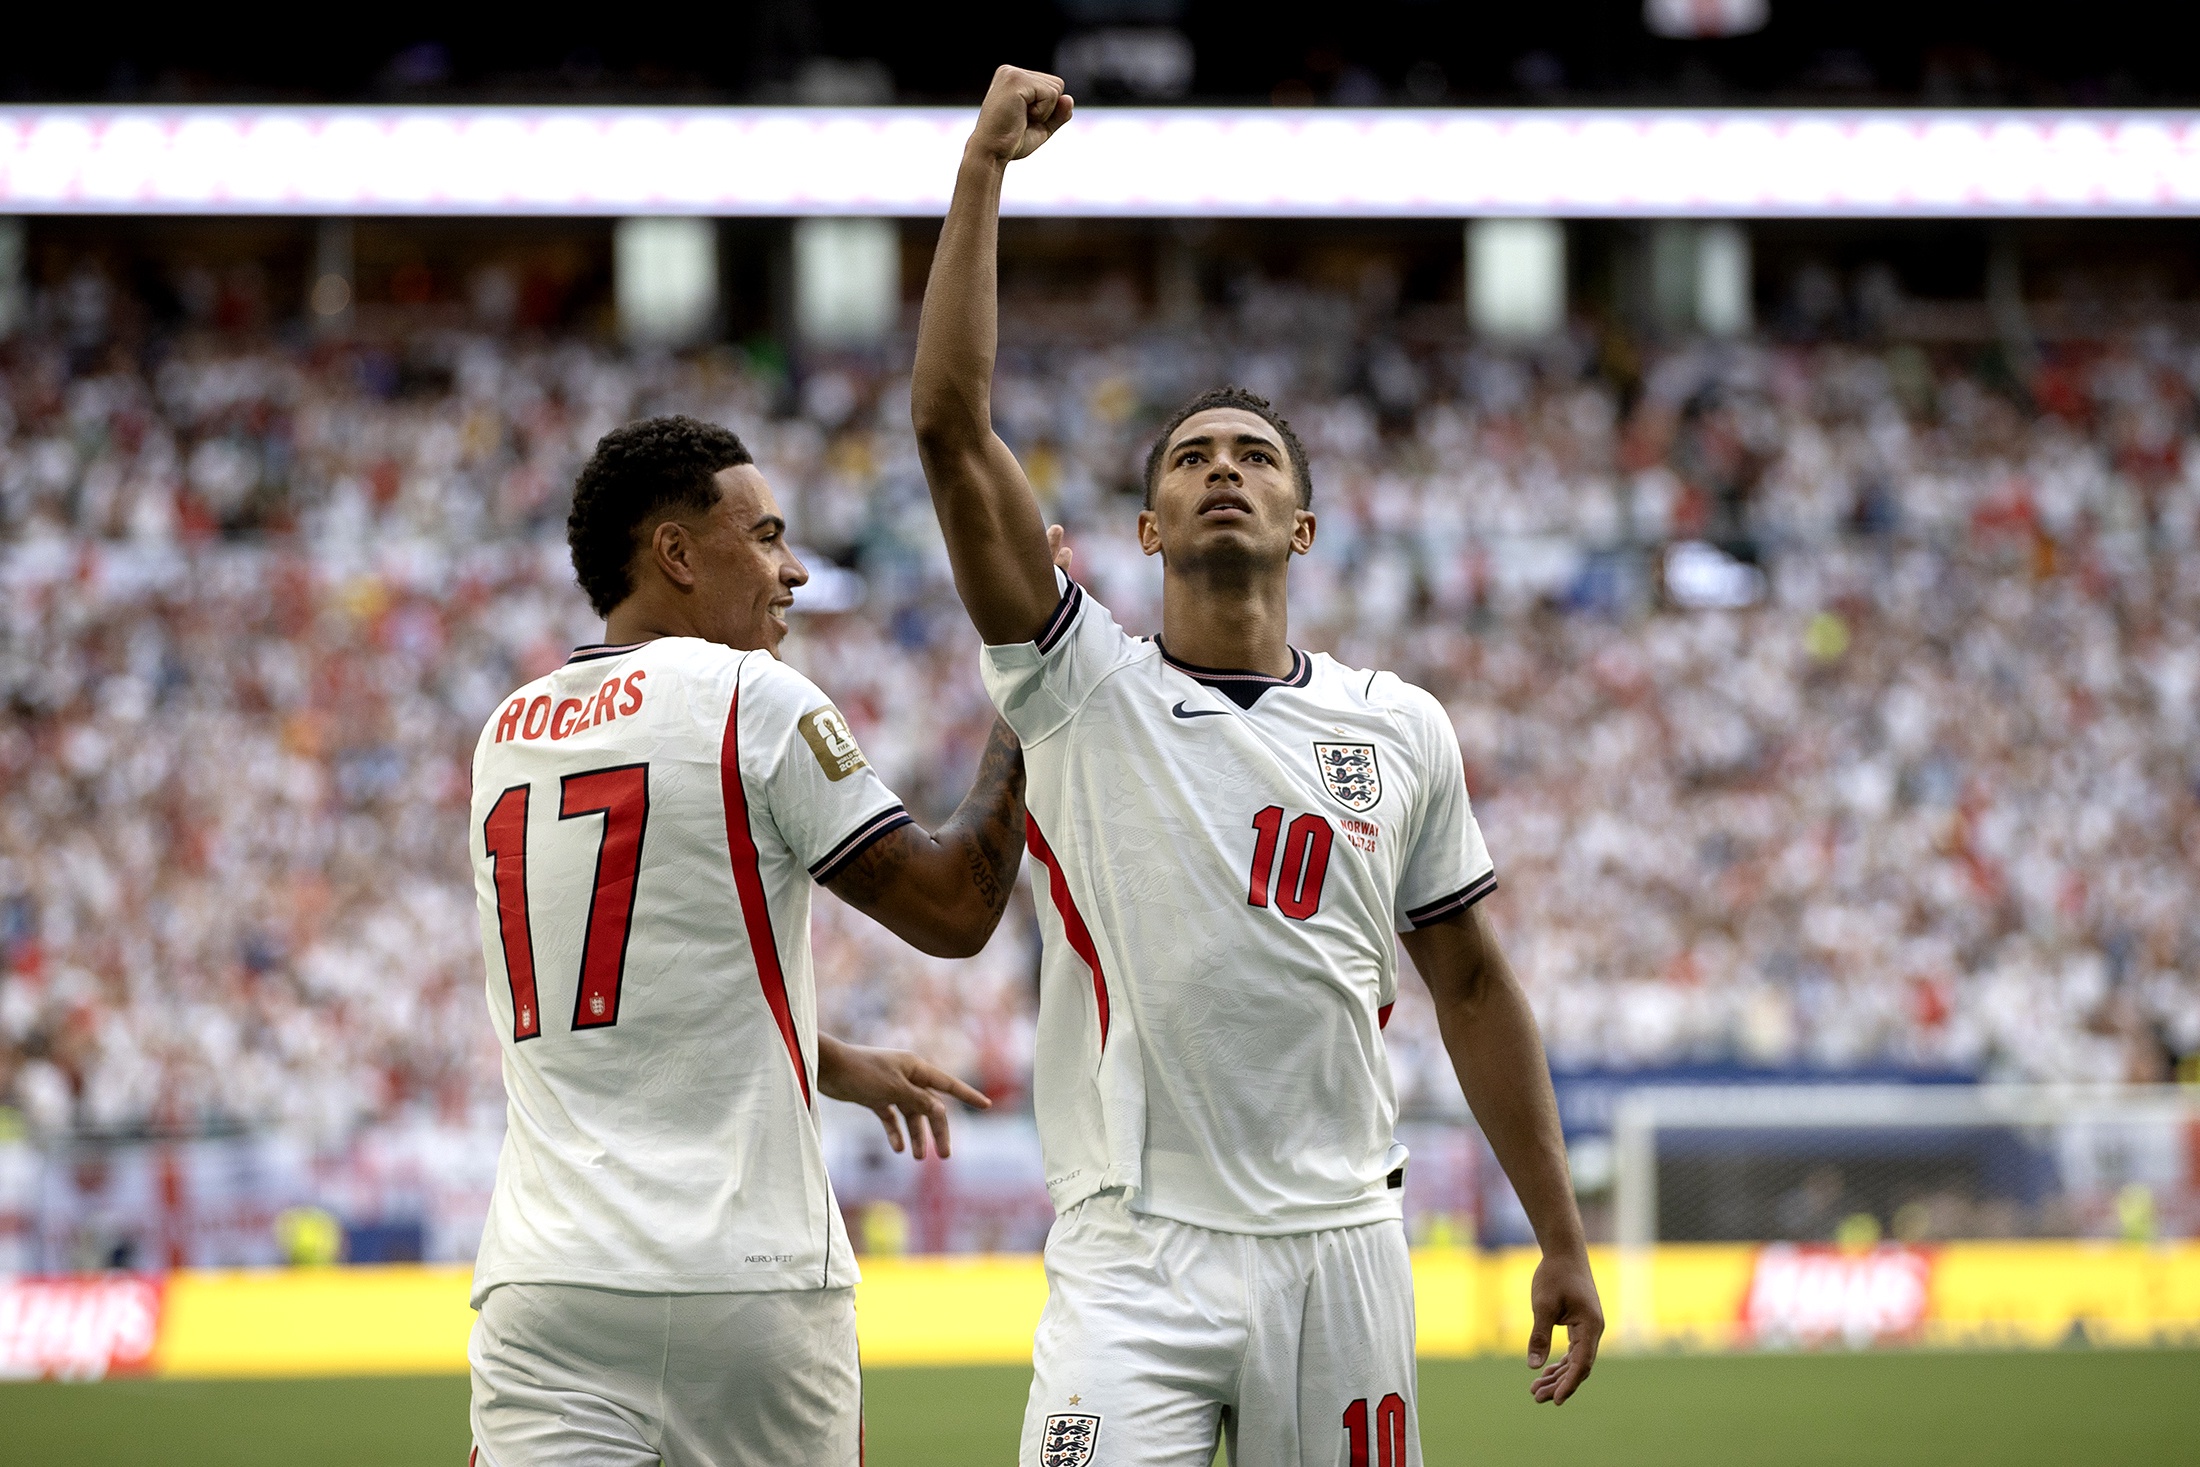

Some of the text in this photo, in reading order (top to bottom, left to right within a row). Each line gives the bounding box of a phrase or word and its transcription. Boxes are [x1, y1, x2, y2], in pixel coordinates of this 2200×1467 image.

[495, 670, 646, 744] ROGERS
[837, 742, 850, 752] FIFA
[1247, 805, 1335, 921] 10
[1340, 819, 1379, 837] NORWAY
[483, 762, 650, 1043] 17
[744, 1254, 793, 1263] AERO-FIT
[1343, 1392, 1406, 1467] 10
